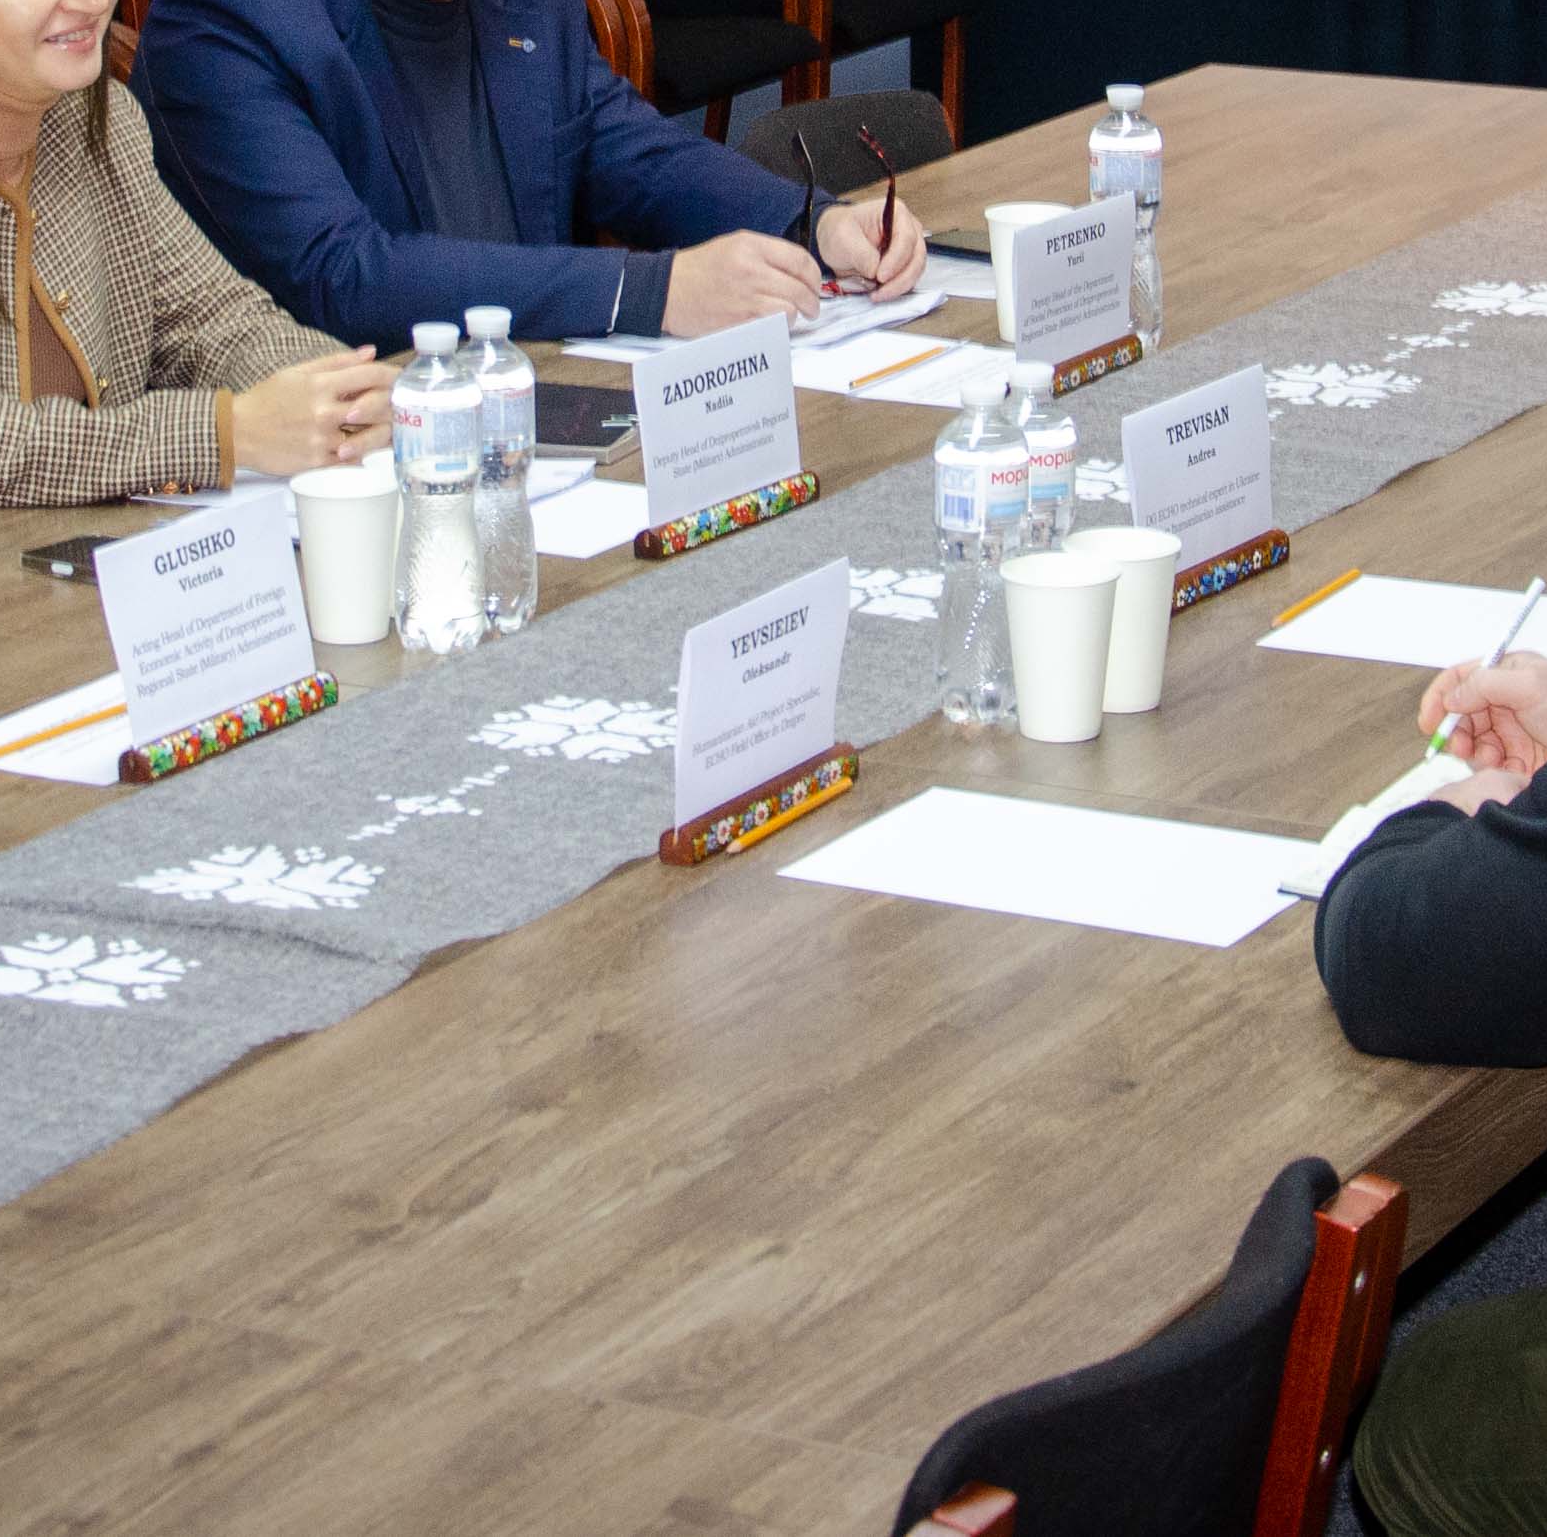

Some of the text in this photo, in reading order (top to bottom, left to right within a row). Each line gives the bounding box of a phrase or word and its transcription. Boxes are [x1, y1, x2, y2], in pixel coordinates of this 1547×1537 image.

[1046, 222, 1106, 255] PETRENKO
[663, 352, 769, 406] ZADOROZHNA
[1166, 405, 1229, 445] TREVISAN
[1188, 447, 1216, 467] Andrea
[154, 528, 235, 576] GLUSHKO
[179, 565, 224, 592] Victoria
[132, 638, 161, 658] Acting
[732, 606, 809, 659] YEVSIEIEV
[742, 651, 792, 684] Oleksandr
